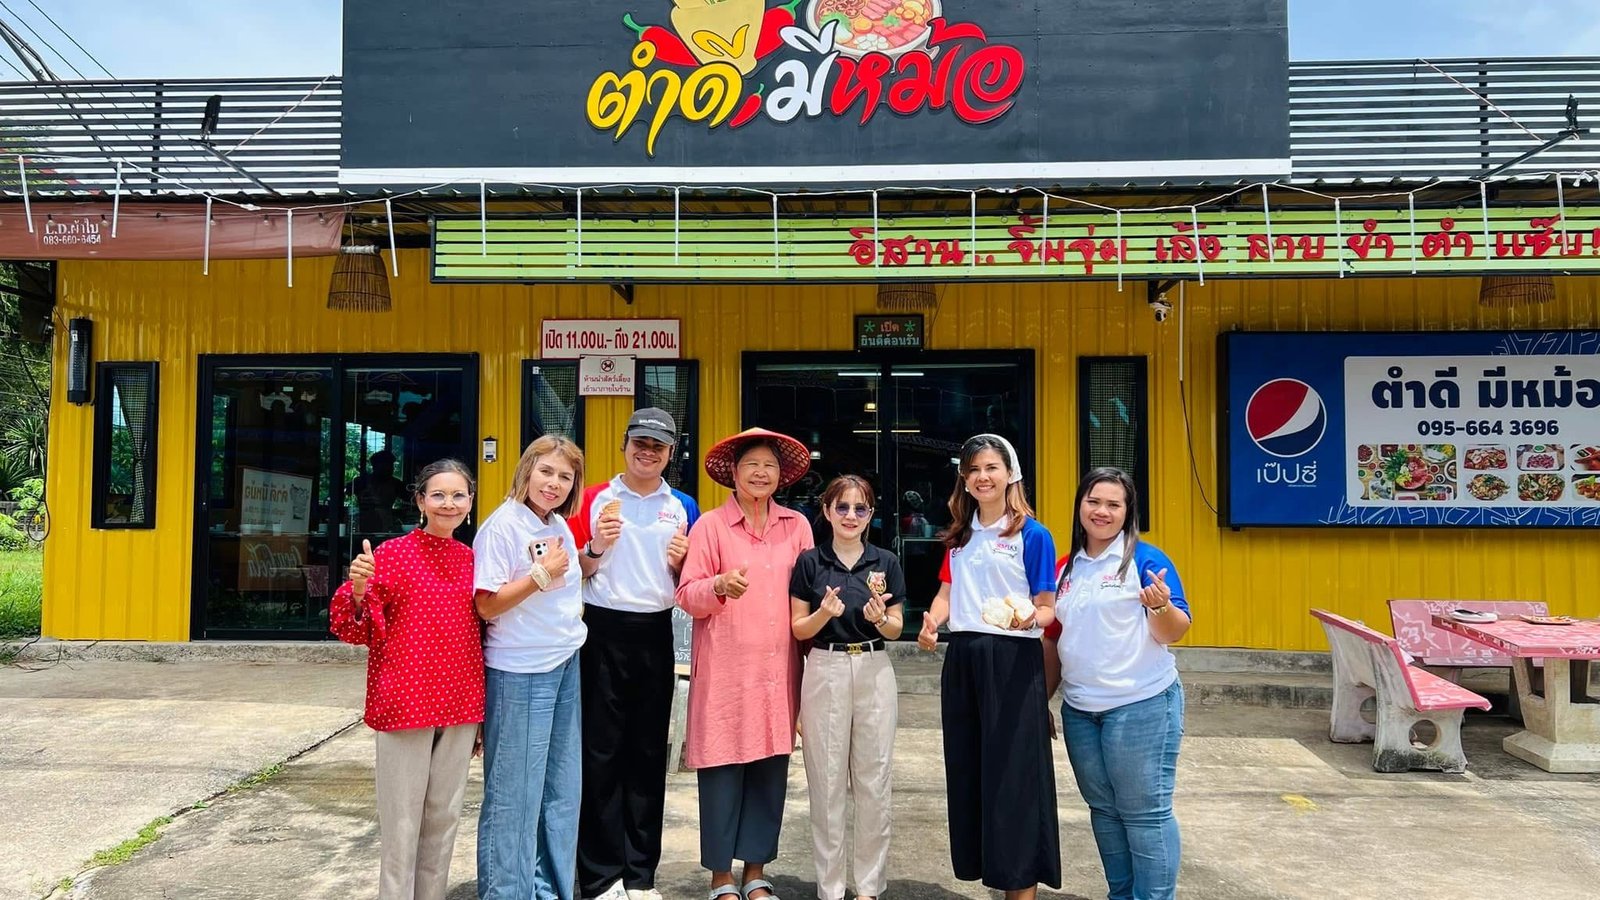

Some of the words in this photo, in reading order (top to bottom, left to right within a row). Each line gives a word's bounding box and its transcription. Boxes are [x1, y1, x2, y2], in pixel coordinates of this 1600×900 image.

[1156, 221, 1222, 261] เล้ง
[1247, 234, 1325, 260] ลาบ
[1347, 218, 1395, 259] ยำ
[1421, 217, 1474, 258] ตำ
[880, 321, 900, 332] เปิด
[545, 329, 563, 349] เปิด
[632, 330, 677, 349] 21.00น.
[860, 333, 920, 346] ยินดีต้อนรับ
[1371, 366, 1461, 409] ตำดี
[1478, 366, 1600, 409] มีหม้อ
[1417, 420, 1504, 436] 095-664
[1509, 420, 1560, 436] 3696
[1256, 460, 1318, 484] เป๊ปซี่
